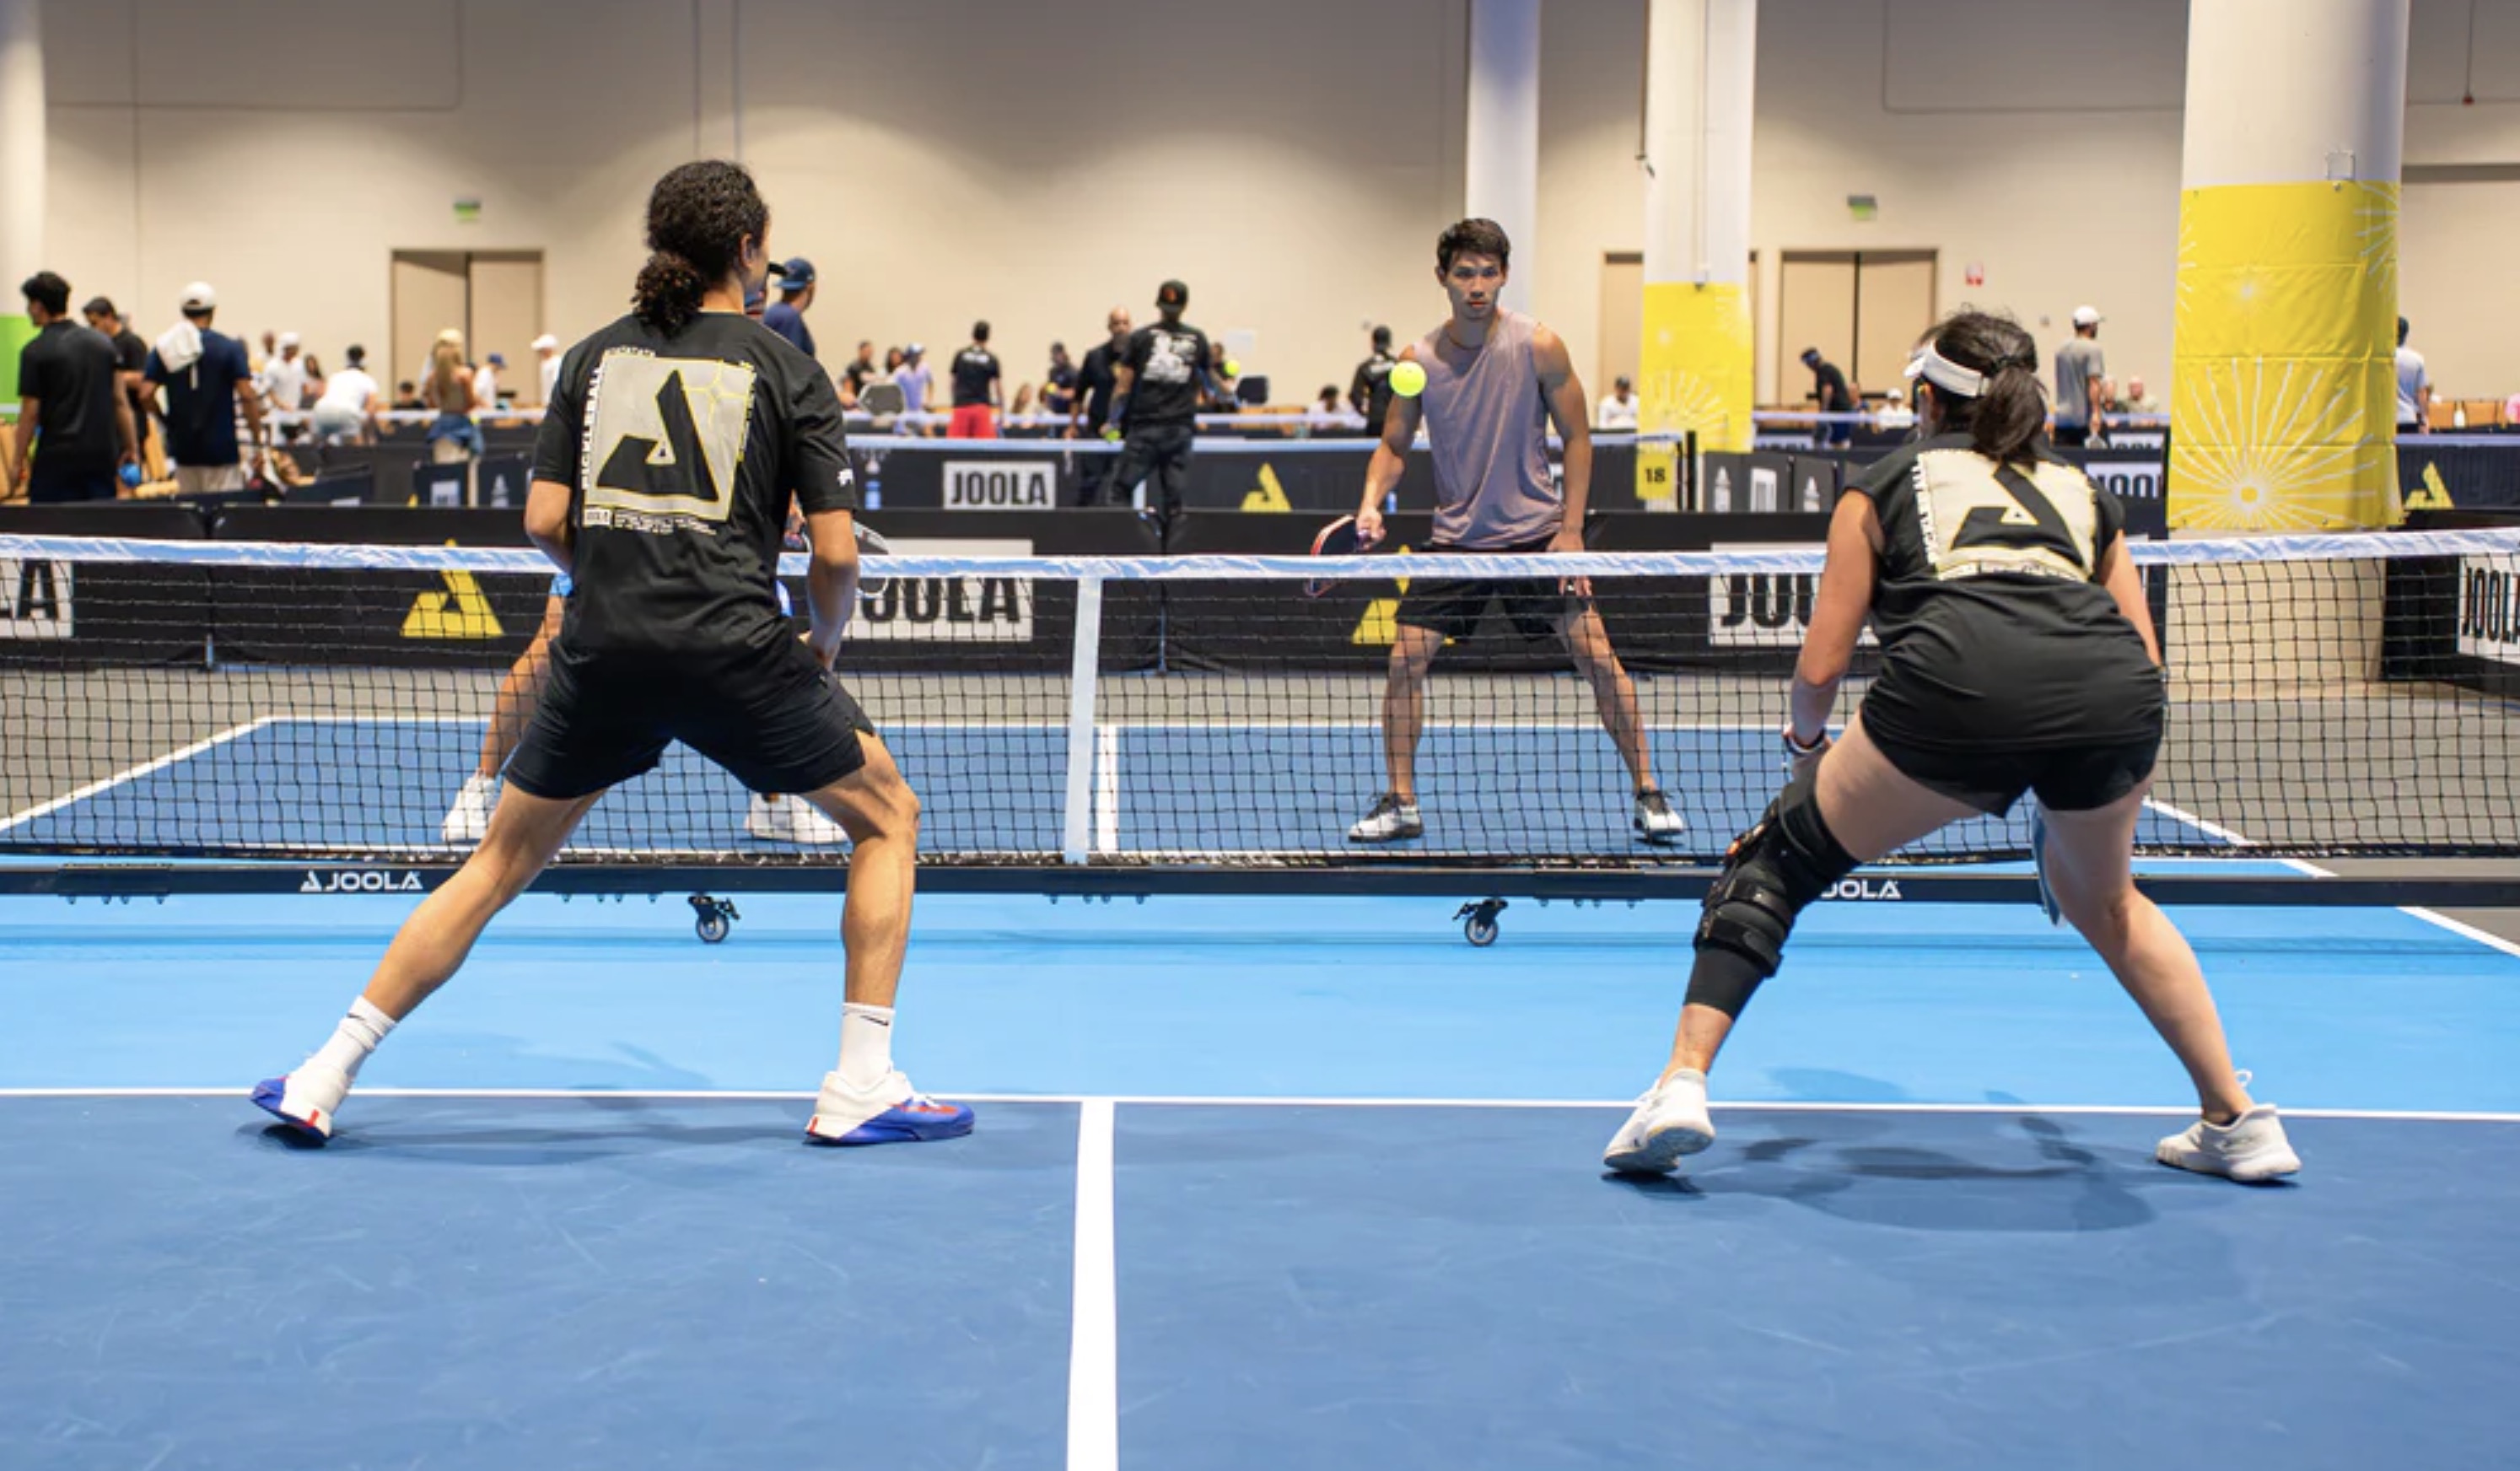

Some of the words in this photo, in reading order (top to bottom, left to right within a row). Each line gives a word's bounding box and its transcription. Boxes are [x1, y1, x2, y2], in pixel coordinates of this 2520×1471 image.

[1644, 468, 1666, 482] 18
[951, 471, 1047, 505] JOOLA
[326, 870, 423, 891] JOOLA
